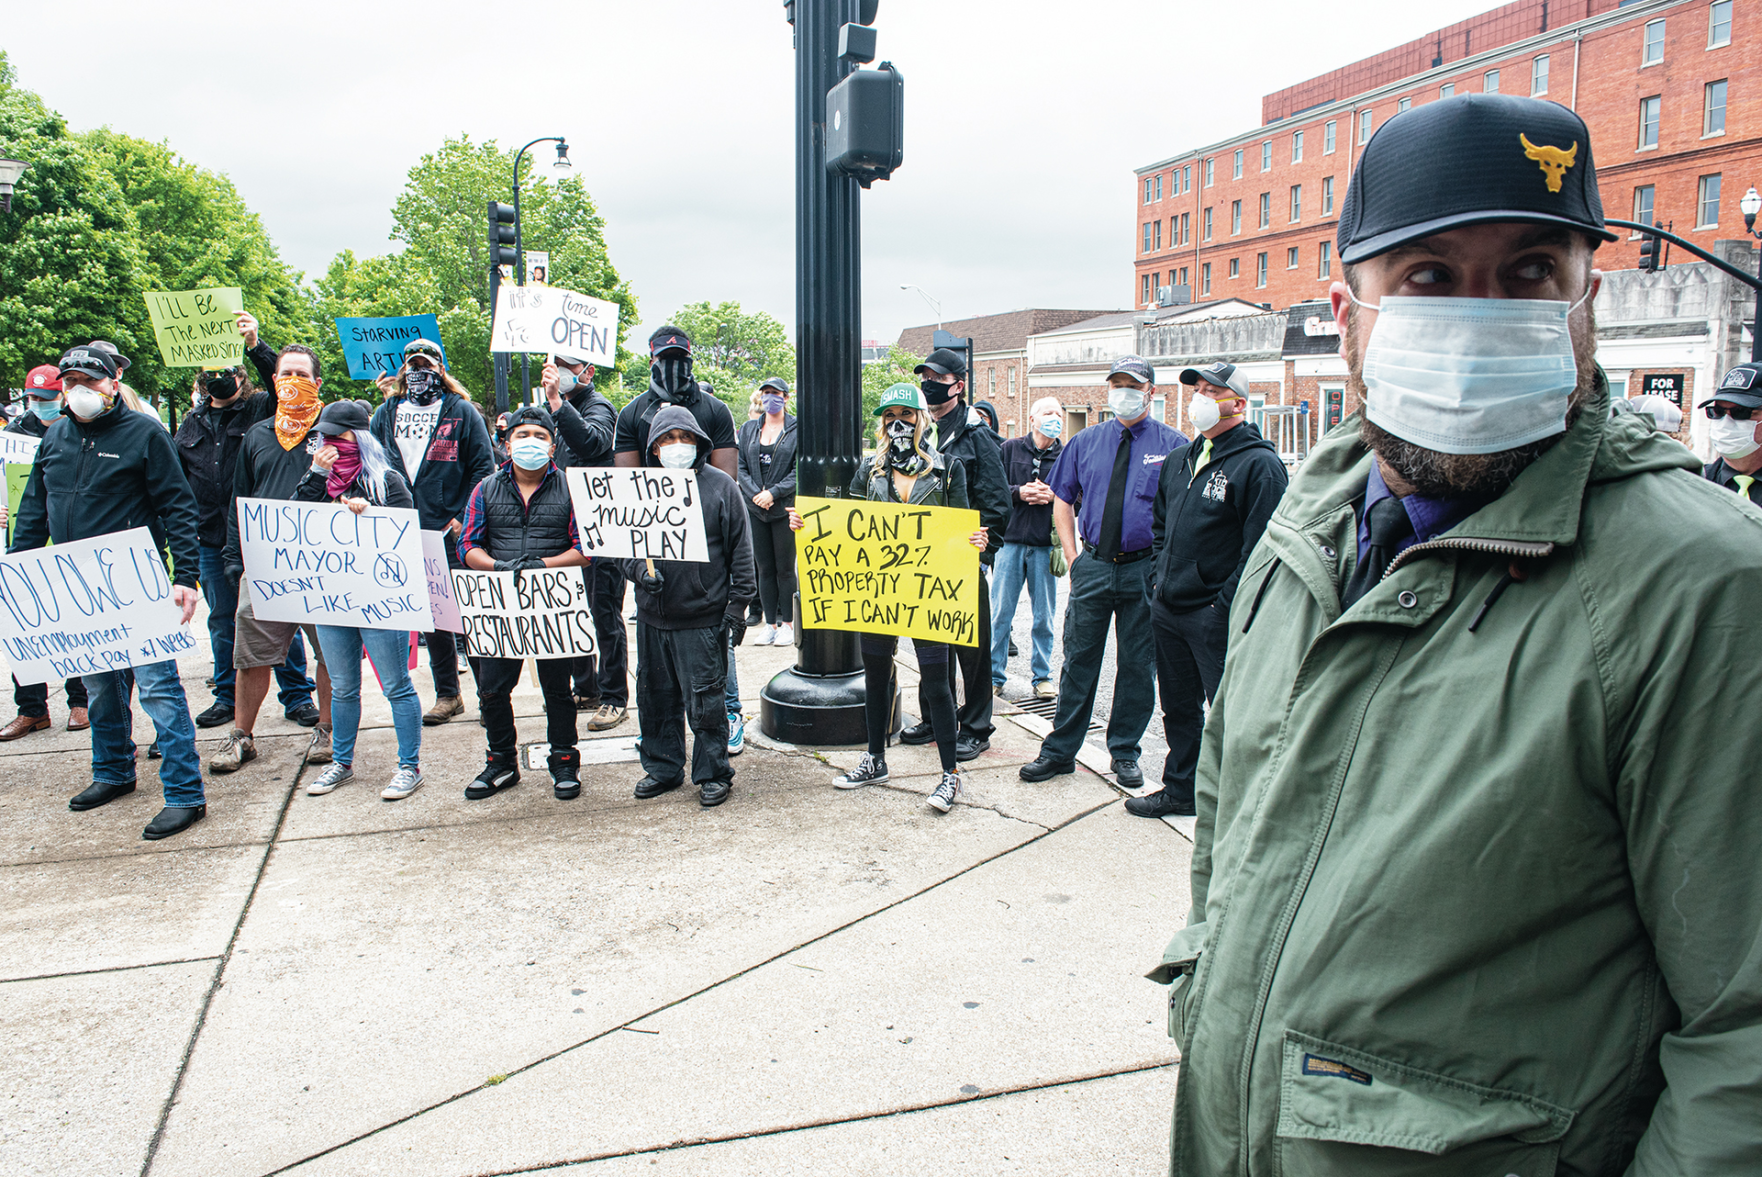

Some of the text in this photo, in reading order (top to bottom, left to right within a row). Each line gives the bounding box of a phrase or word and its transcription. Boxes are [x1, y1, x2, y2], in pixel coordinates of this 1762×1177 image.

[562, 292, 598, 319] time
[551, 316, 608, 355] OPEN
[361, 351, 407, 371] ARTI
[1651, 378, 1674, 389] FOR
[396, 413, 438, 423] SOCCE
[1331, 391, 1341, 425] OPE
[583, 470, 675, 501] let the
[244, 502, 410, 550] MUSIC CITY
[592, 499, 687, 528] music
[802, 504, 932, 543] I CAN'T
[630, 528, 687, 560] PLAY
[804, 543, 932, 571] PAY A 32%
[274, 548, 364, 575] MAYOR
[54, 547, 134, 617] OWE
[129, 547, 171, 602] US
[253, 575, 324, 602] DOESN'T
[456, 574, 506, 611] OPEN
[515, 571, 573, 611] BARS
[806, 567, 964, 602] PROPERTY TAX
[303, 591, 360, 614] LIKE
[360, 593, 423, 625] MUSIC
[808, 597, 975, 644] IF I CAN'T WORK
[462, 609, 595, 658] RESTAURANTS
[49, 653, 106, 679] back
